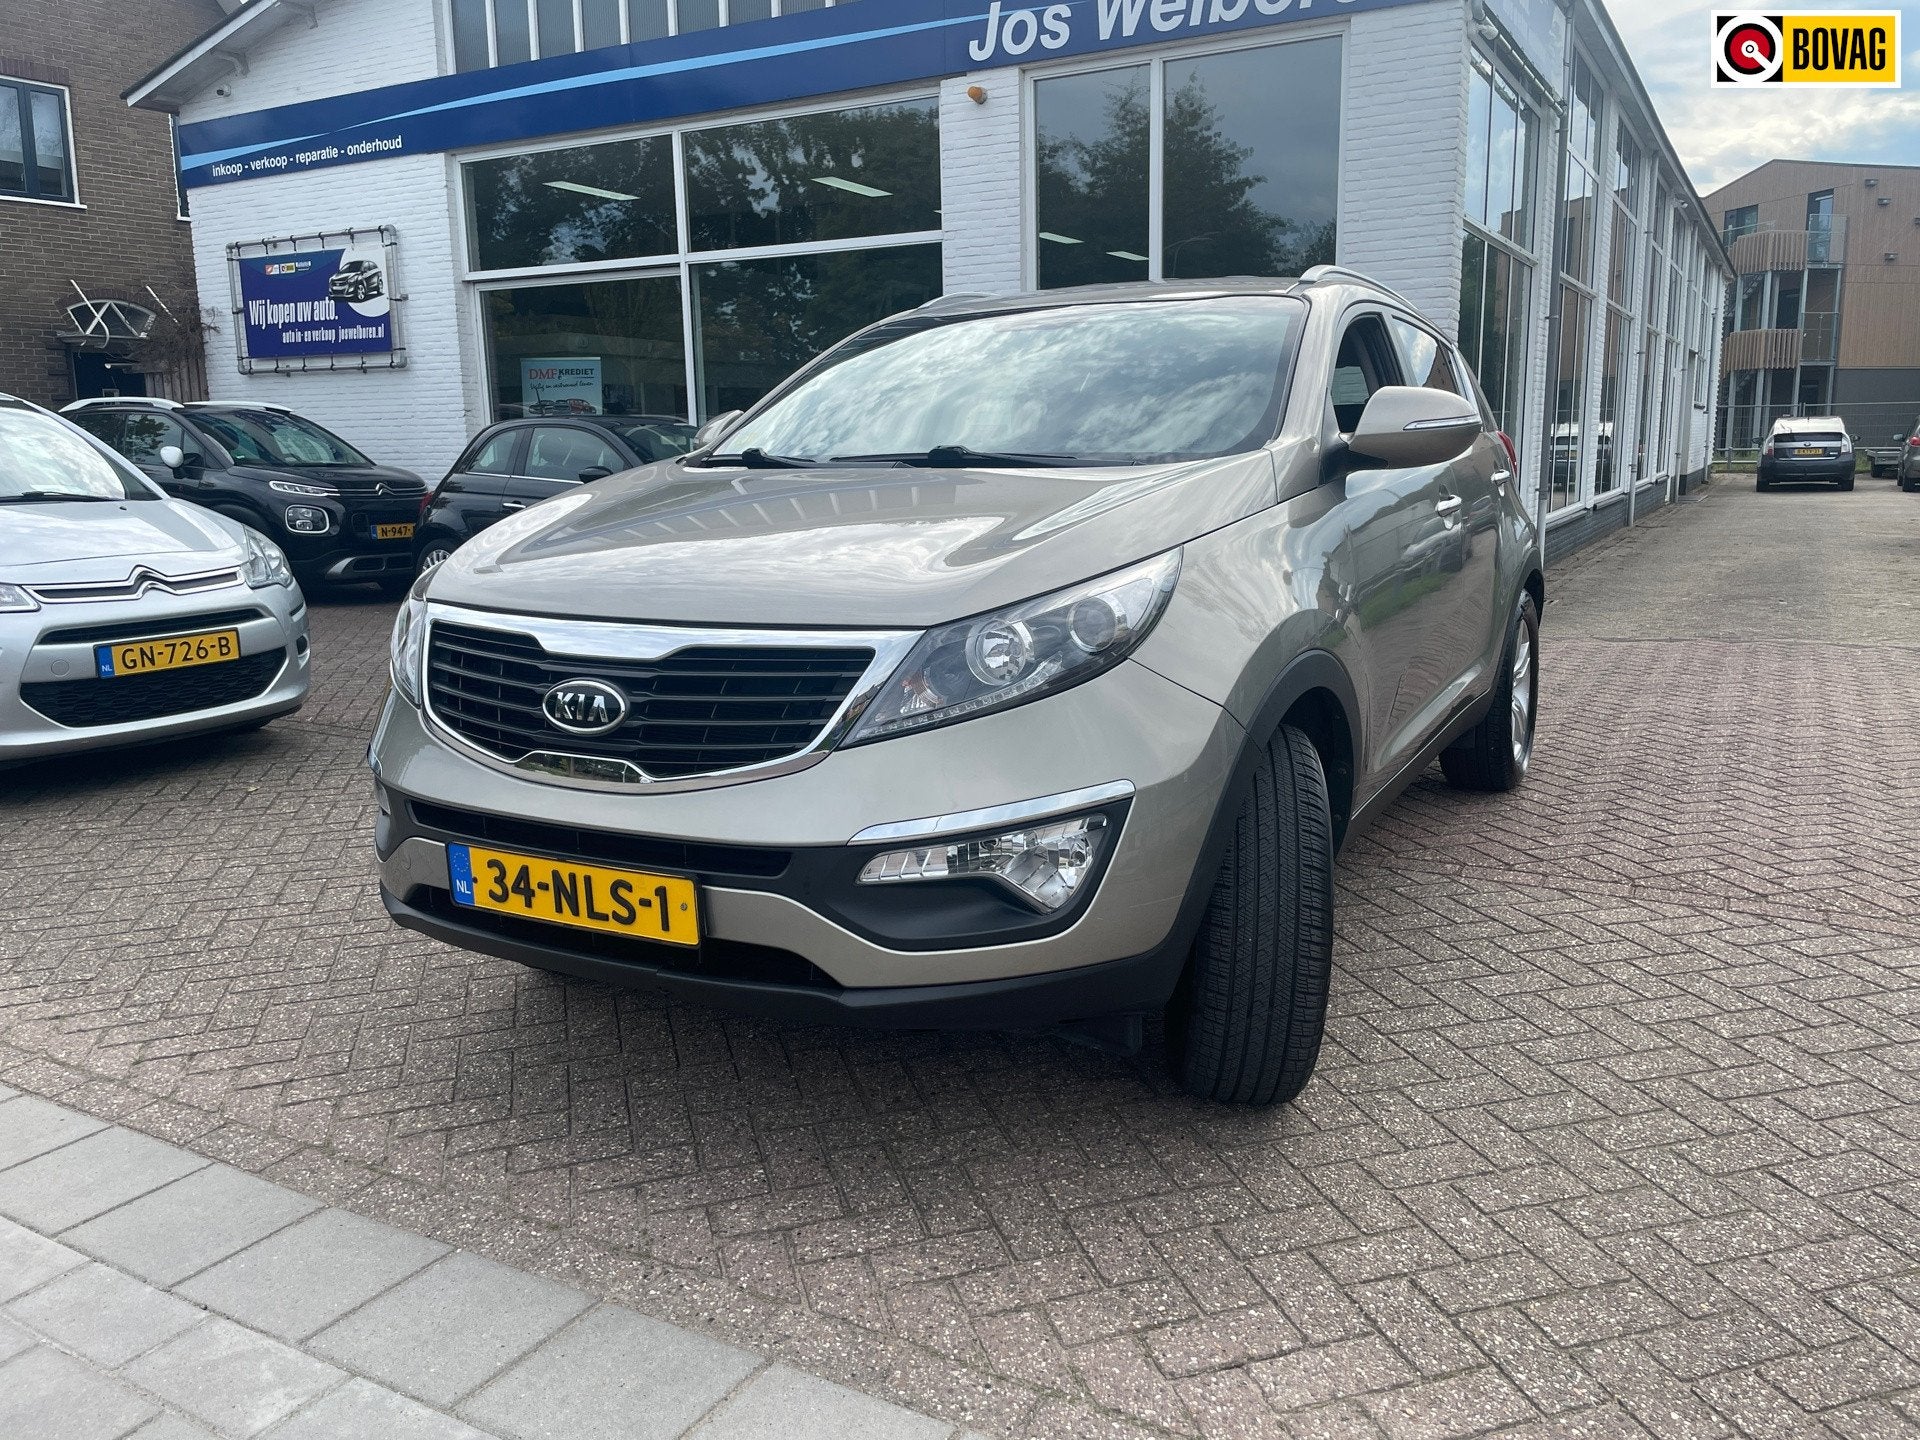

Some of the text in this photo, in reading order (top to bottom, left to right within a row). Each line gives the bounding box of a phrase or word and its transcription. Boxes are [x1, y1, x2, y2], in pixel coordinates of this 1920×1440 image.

[968, 2, 1071, 62] Jos
[212, 163, 243, 177] inkoop
[250, 155, 288, 169] verkoop
[295, 146, 339, 165] reparatie
[347, 135, 402, 156] onderhoud
[248, 296, 338, 330] Wij kopen uw auto.
[282, 330, 295, 343] auto
[304, 330, 311, 342] en
[312, 326, 336, 343] verkoop
[558, 368, 595, 376] KREDIET
[381, 525, 416, 538] N-947-
[101, 636, 231, 672] NL GN-726-B
[554, 691, 609, 723] KIA
[456, 858, 670, 932] NL 34-NLS-1
